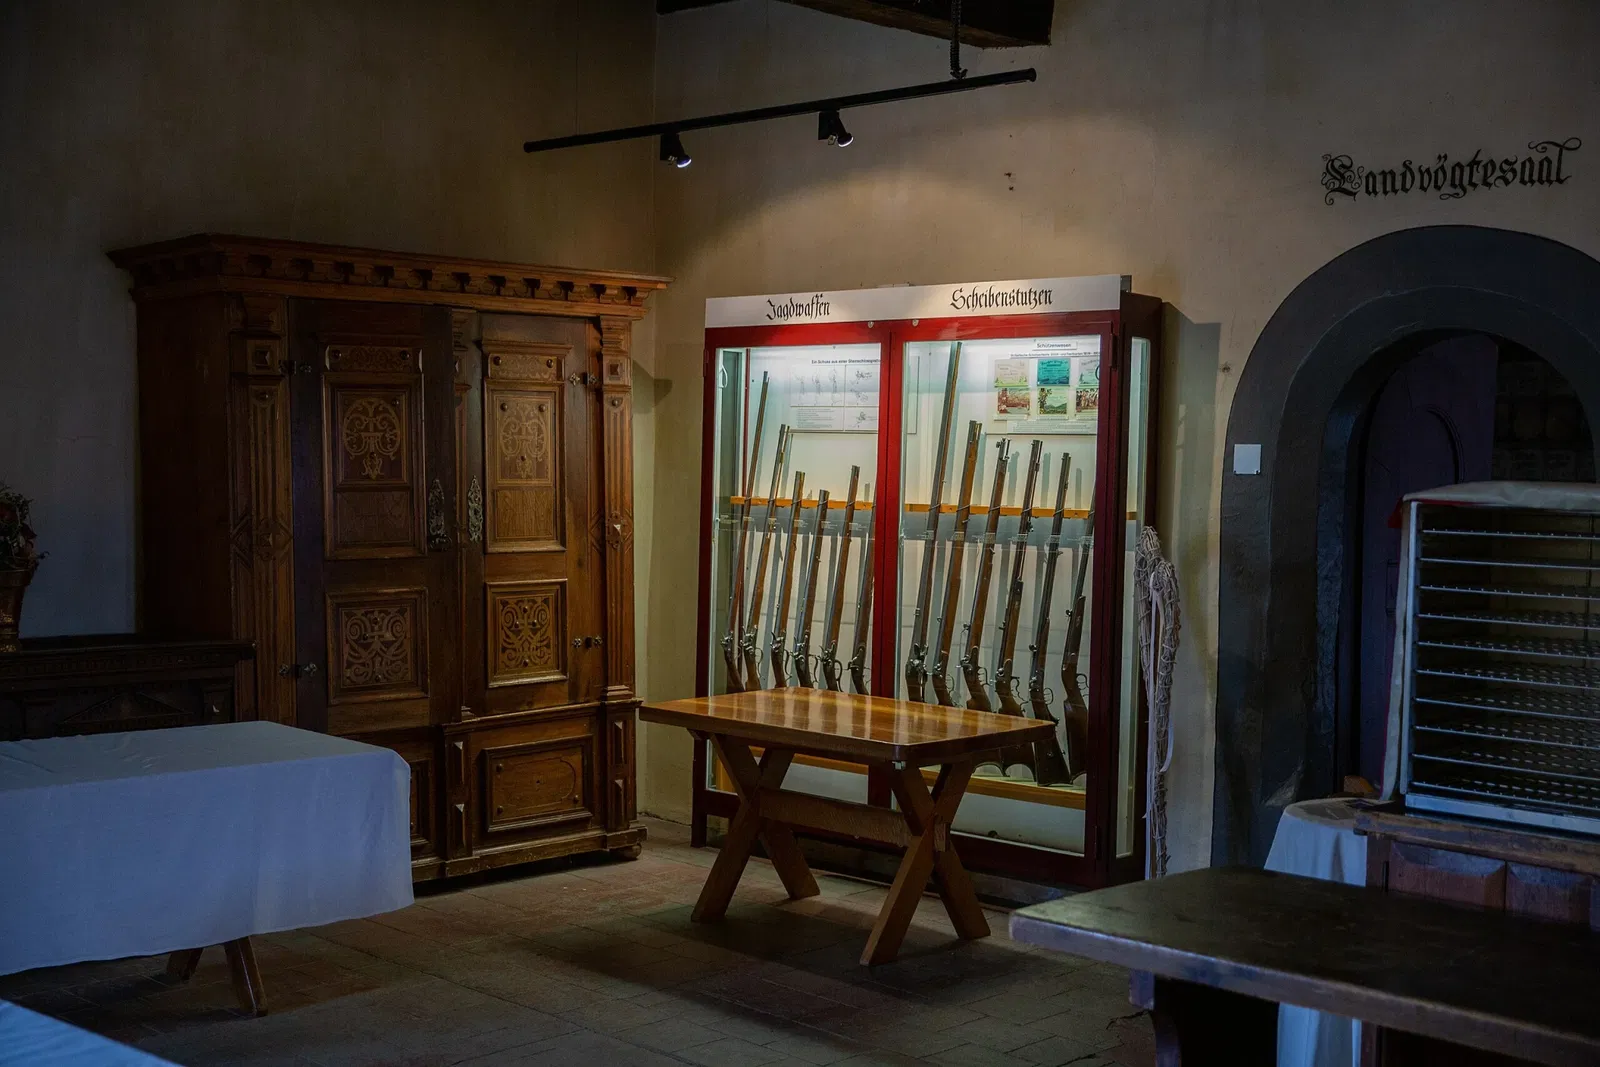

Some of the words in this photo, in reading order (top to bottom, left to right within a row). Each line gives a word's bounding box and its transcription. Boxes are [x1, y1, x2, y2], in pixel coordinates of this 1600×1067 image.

[1321, 137, 1582, 205] Landvögtesaal
[766, 293, 830, 321] Jagdwaffen
[951, 284, 1053, 312] Scheibenstutzen
